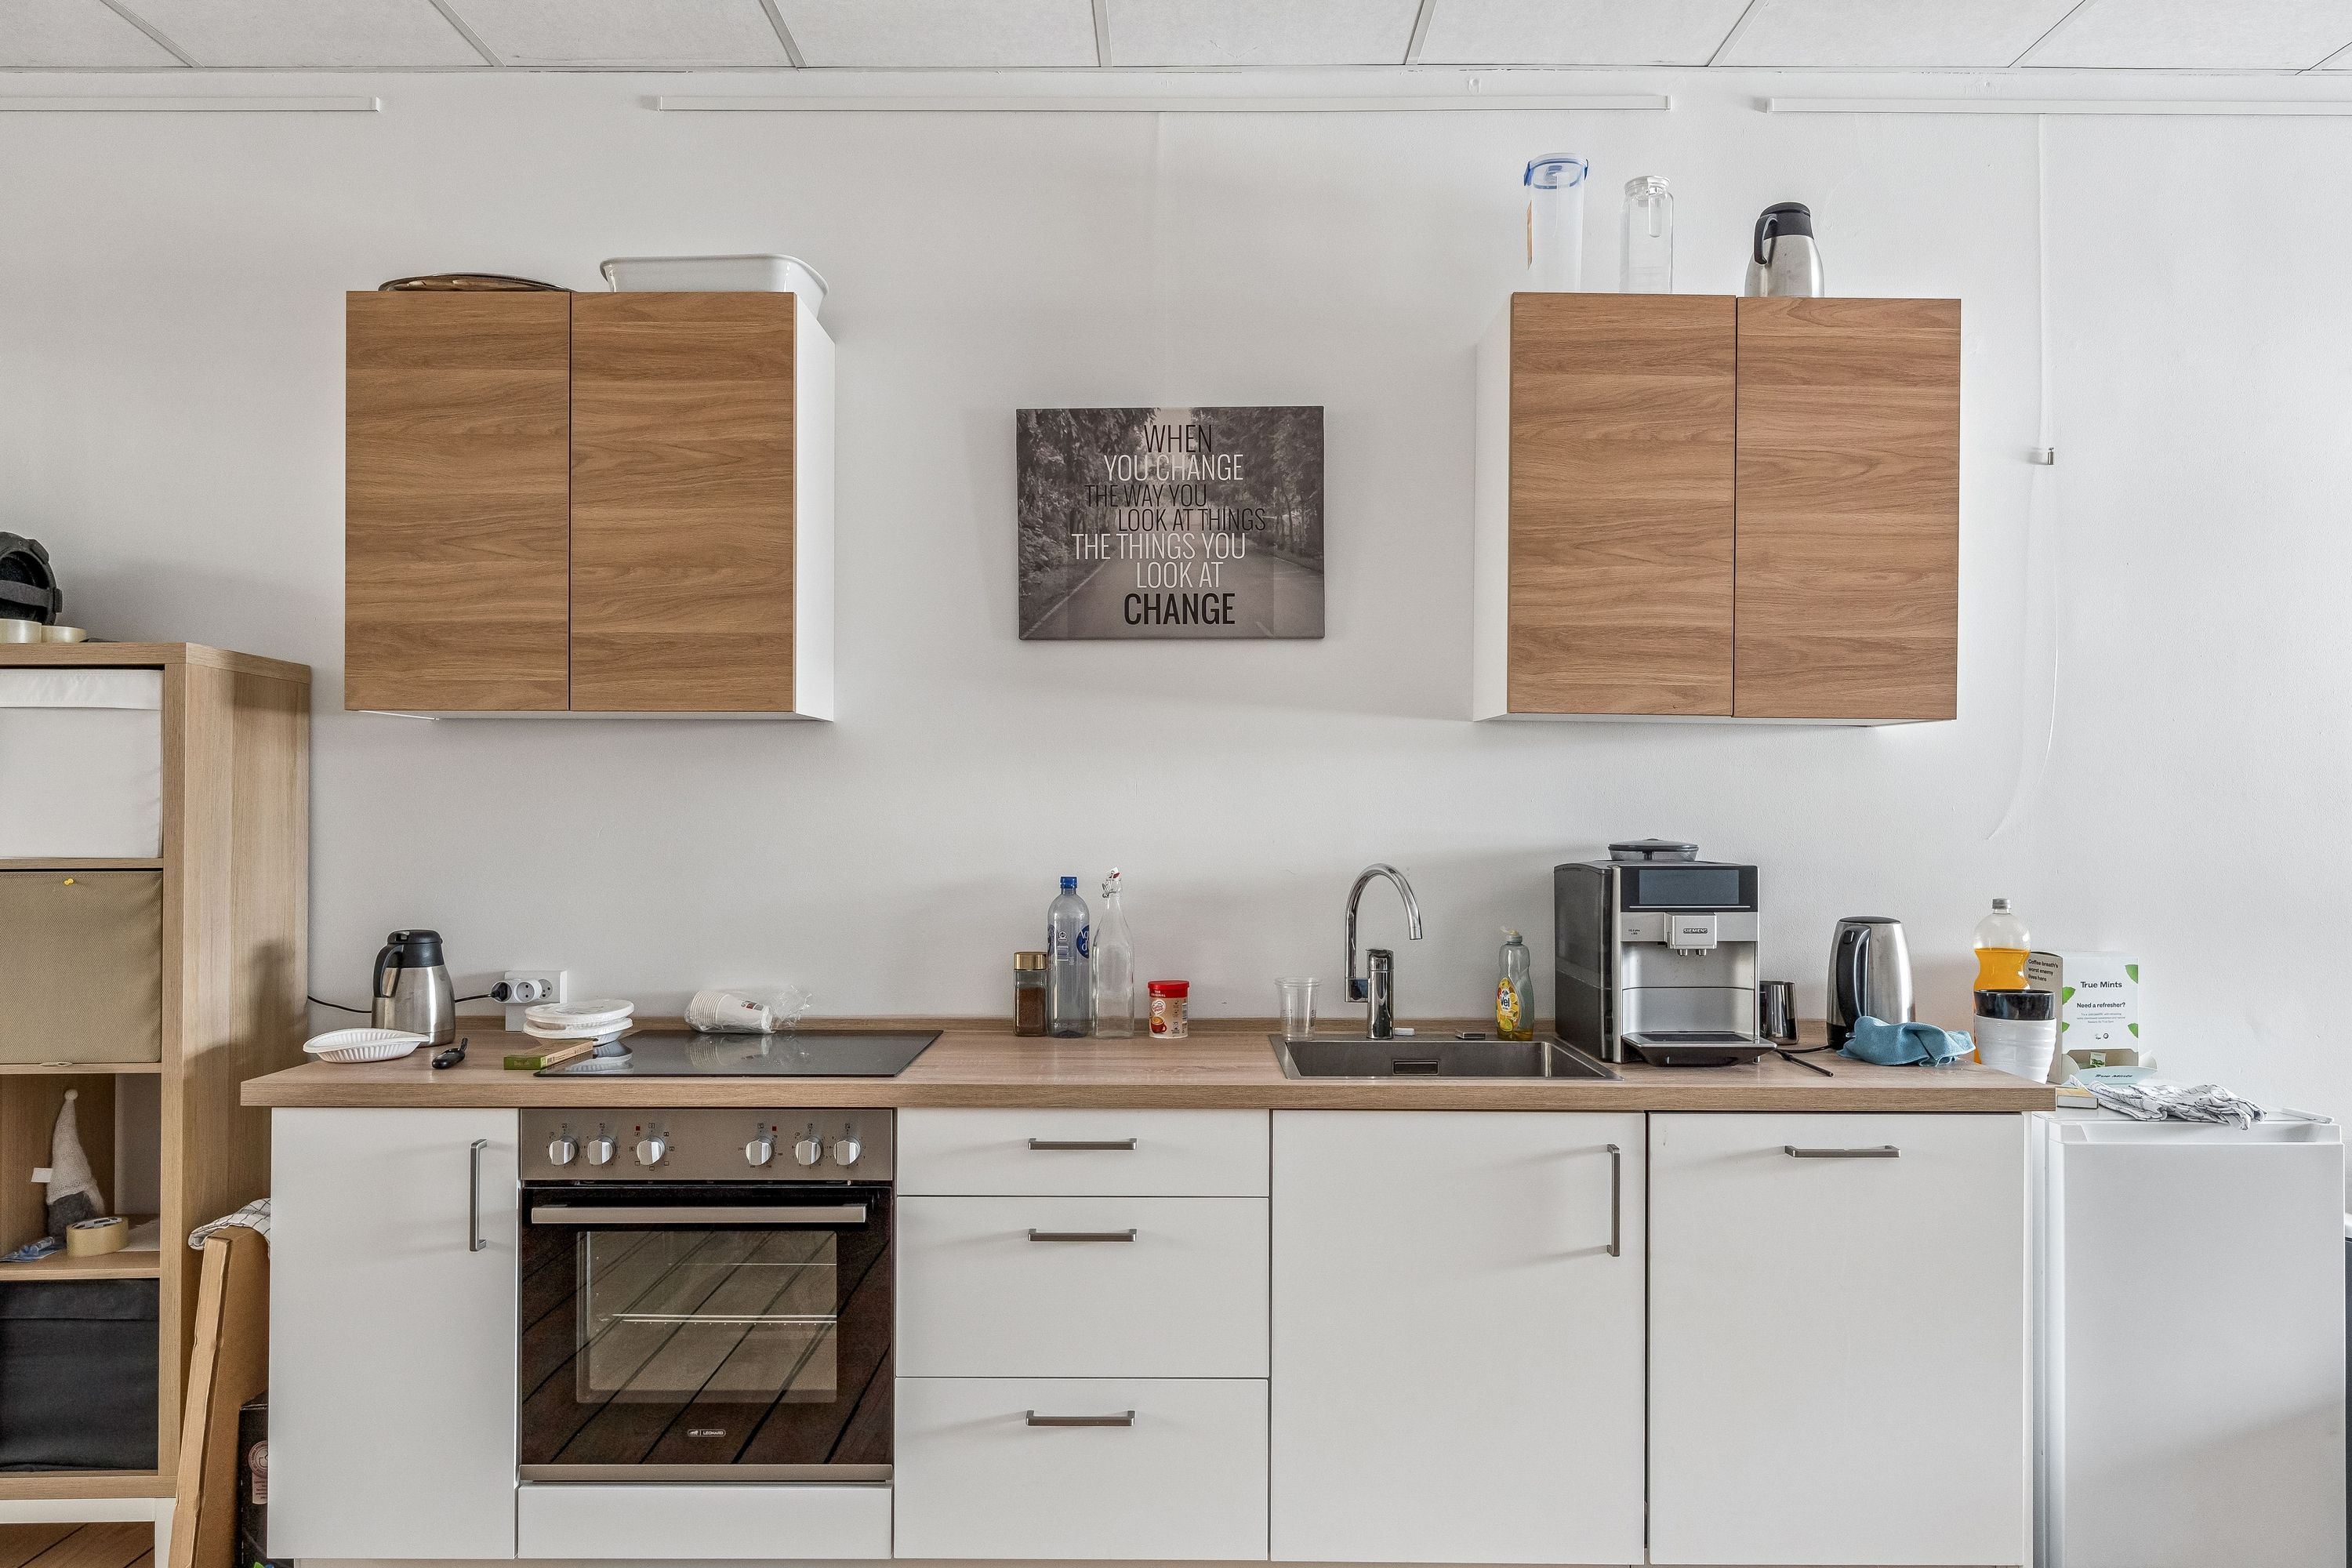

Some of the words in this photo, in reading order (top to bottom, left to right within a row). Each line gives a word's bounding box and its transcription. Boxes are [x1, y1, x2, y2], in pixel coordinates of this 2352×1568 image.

[1143, 424, 1212, 453] WHEN
[1104, 455, 1147, 481] YOU
[1156, 454, 1243, 481] CHANGE
[1084, 485, 1119, 507] THE
[1123, 485, 1163, 507] WAY
[1170, 484, 1207, 506] YOU
[1119, 509, 1167, 532] LOOK
[1172, 509, 1194, 532] AT
[1200, 508, 1266, 531] THINGS
[1071, 533, 1111, 560] THE
[1116, 532, 1196, 559] THINGS
[1201, 532, 1246, 559] YOU
[1137, 561, 1193, 588] LOOK
[1199, 561, 1224, 588] AT
[1123, 593, 1236, 625] CHANGE
[1500, 996, 1510, 1007] Vel
